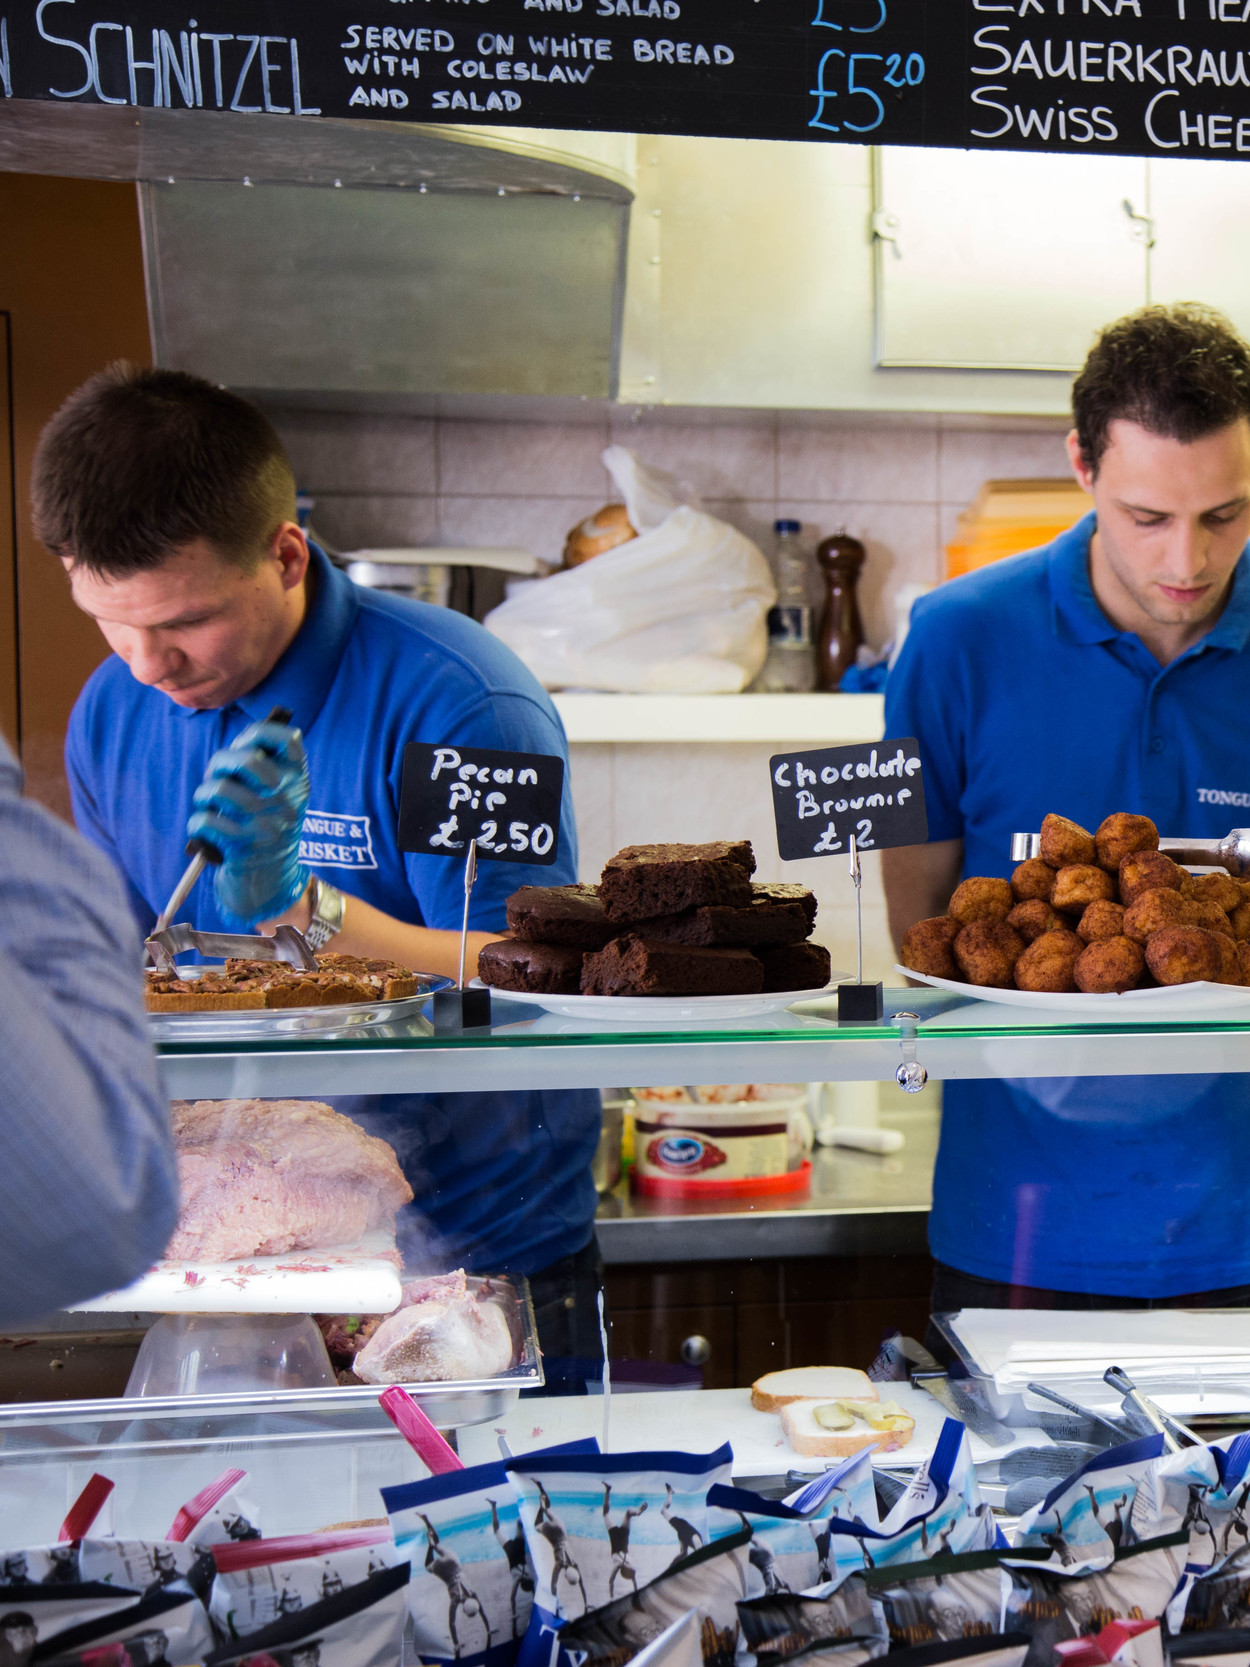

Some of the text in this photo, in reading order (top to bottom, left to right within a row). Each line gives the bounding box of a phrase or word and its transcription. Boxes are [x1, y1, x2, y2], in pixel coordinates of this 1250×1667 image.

[596, 0, 681, 20] SALAD
[37, 0, 321, 116] SCHNITZEL
[341, 26, 734, 64] SERVED ON WHITE BREAD
[345, 54, 594, 83] WITH COLESLAW
[349, 86, 521, 111] AND SALAD
[971, 86, 1118, 141] SWISS
[431, 748, 537, 785] Pecan
[774, 749, 921, 787] Chocolate
[449, 782, 506, 811] Pie
[796, 788, 911, 819] Brownie
[302, 817, 363, 838] NGUE &
[298, 839, 367, 863] RISKET
